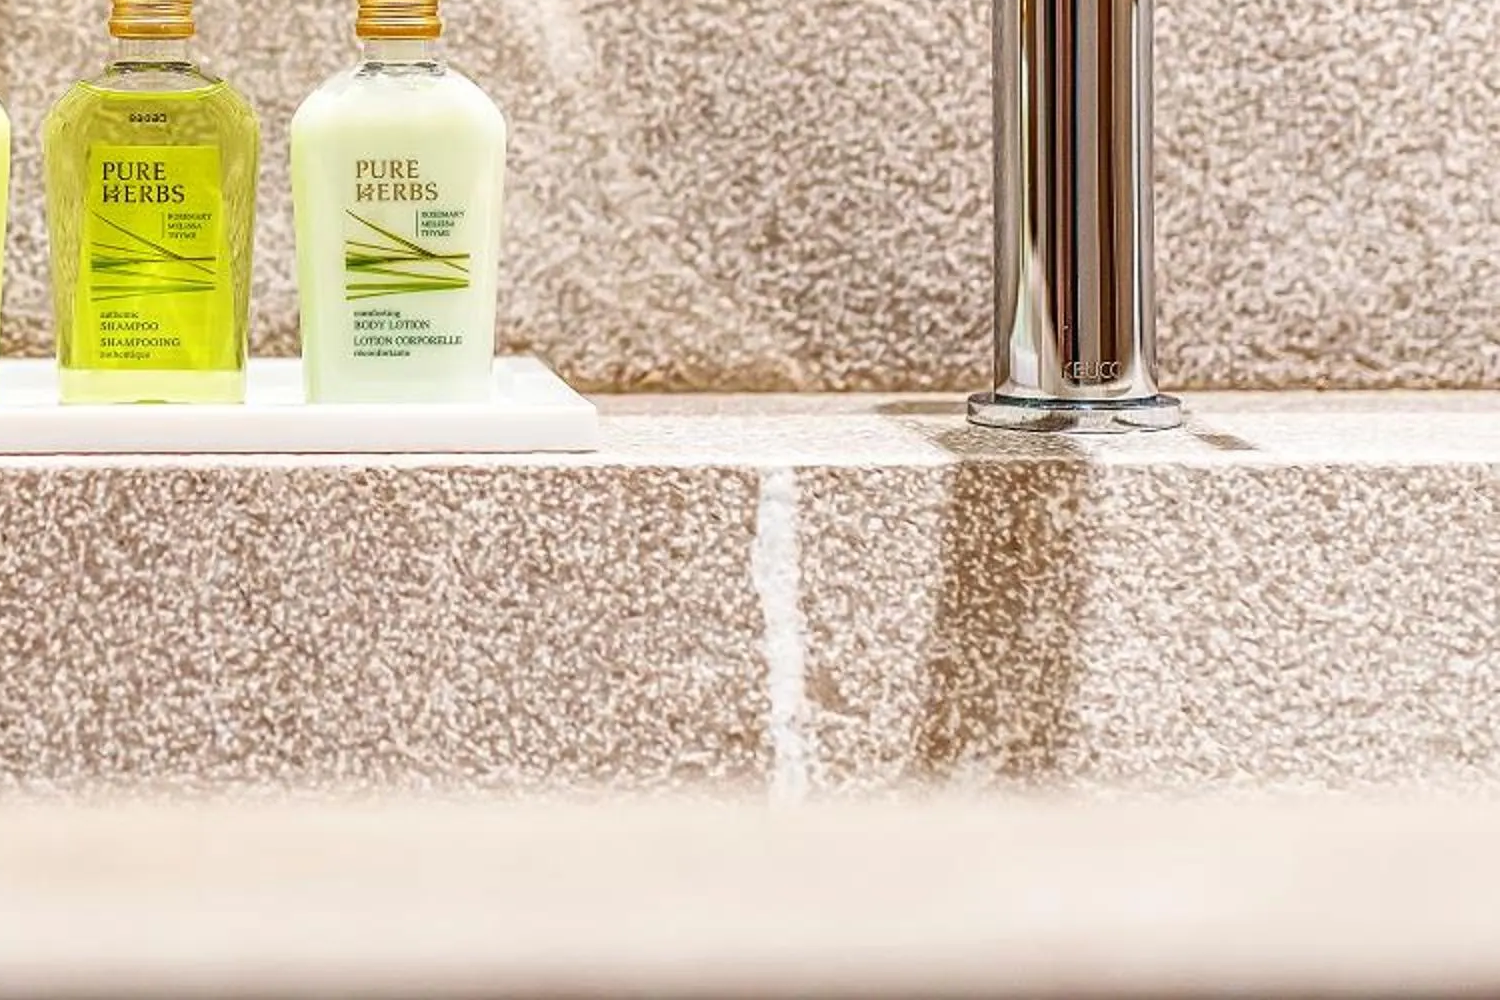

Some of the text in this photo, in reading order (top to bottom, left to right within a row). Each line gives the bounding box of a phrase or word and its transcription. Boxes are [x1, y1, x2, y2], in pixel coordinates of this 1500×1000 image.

[102, 161, 166, 181] PURE
[355, 159, 419, 179] PURE
[102, 184, 185, 203] HERBS
[355, 181, 438, 201] HERBS
[100, 321, 159, 331] SHAMPOO
[354, 319, 431, 330] BODY LOTION
[100, 337, 181, 347] SHAMPOOING
[354, 335, 463, 346] LOTION CORPORELLE
